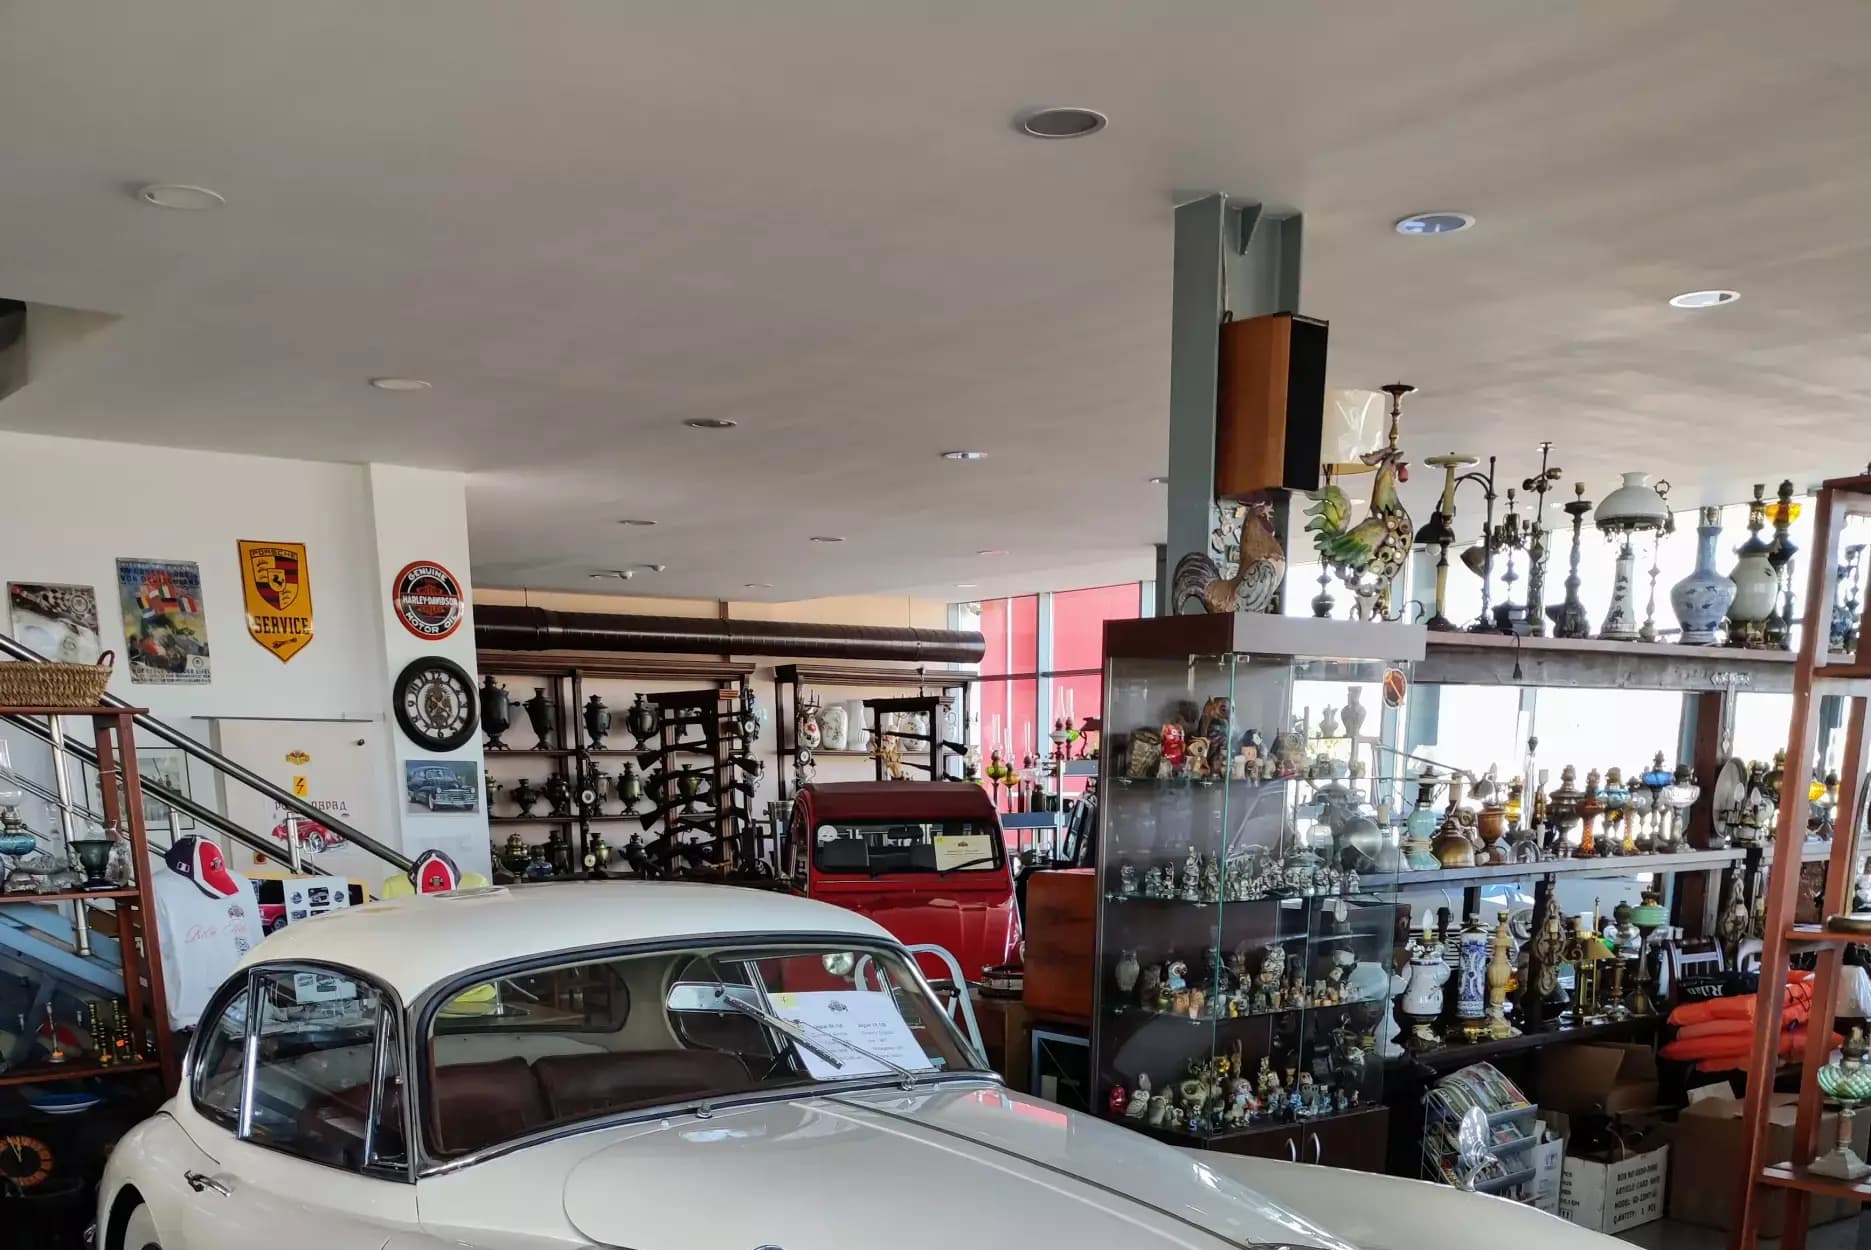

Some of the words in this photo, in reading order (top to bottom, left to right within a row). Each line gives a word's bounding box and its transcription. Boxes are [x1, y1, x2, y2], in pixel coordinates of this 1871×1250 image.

[408, 567, 447, 581] GENUINE
[254, 616, 310, 634] SERVICE
[406, 612, 439, 633] MOTOR
[444, 615, 457, 628] OIL
